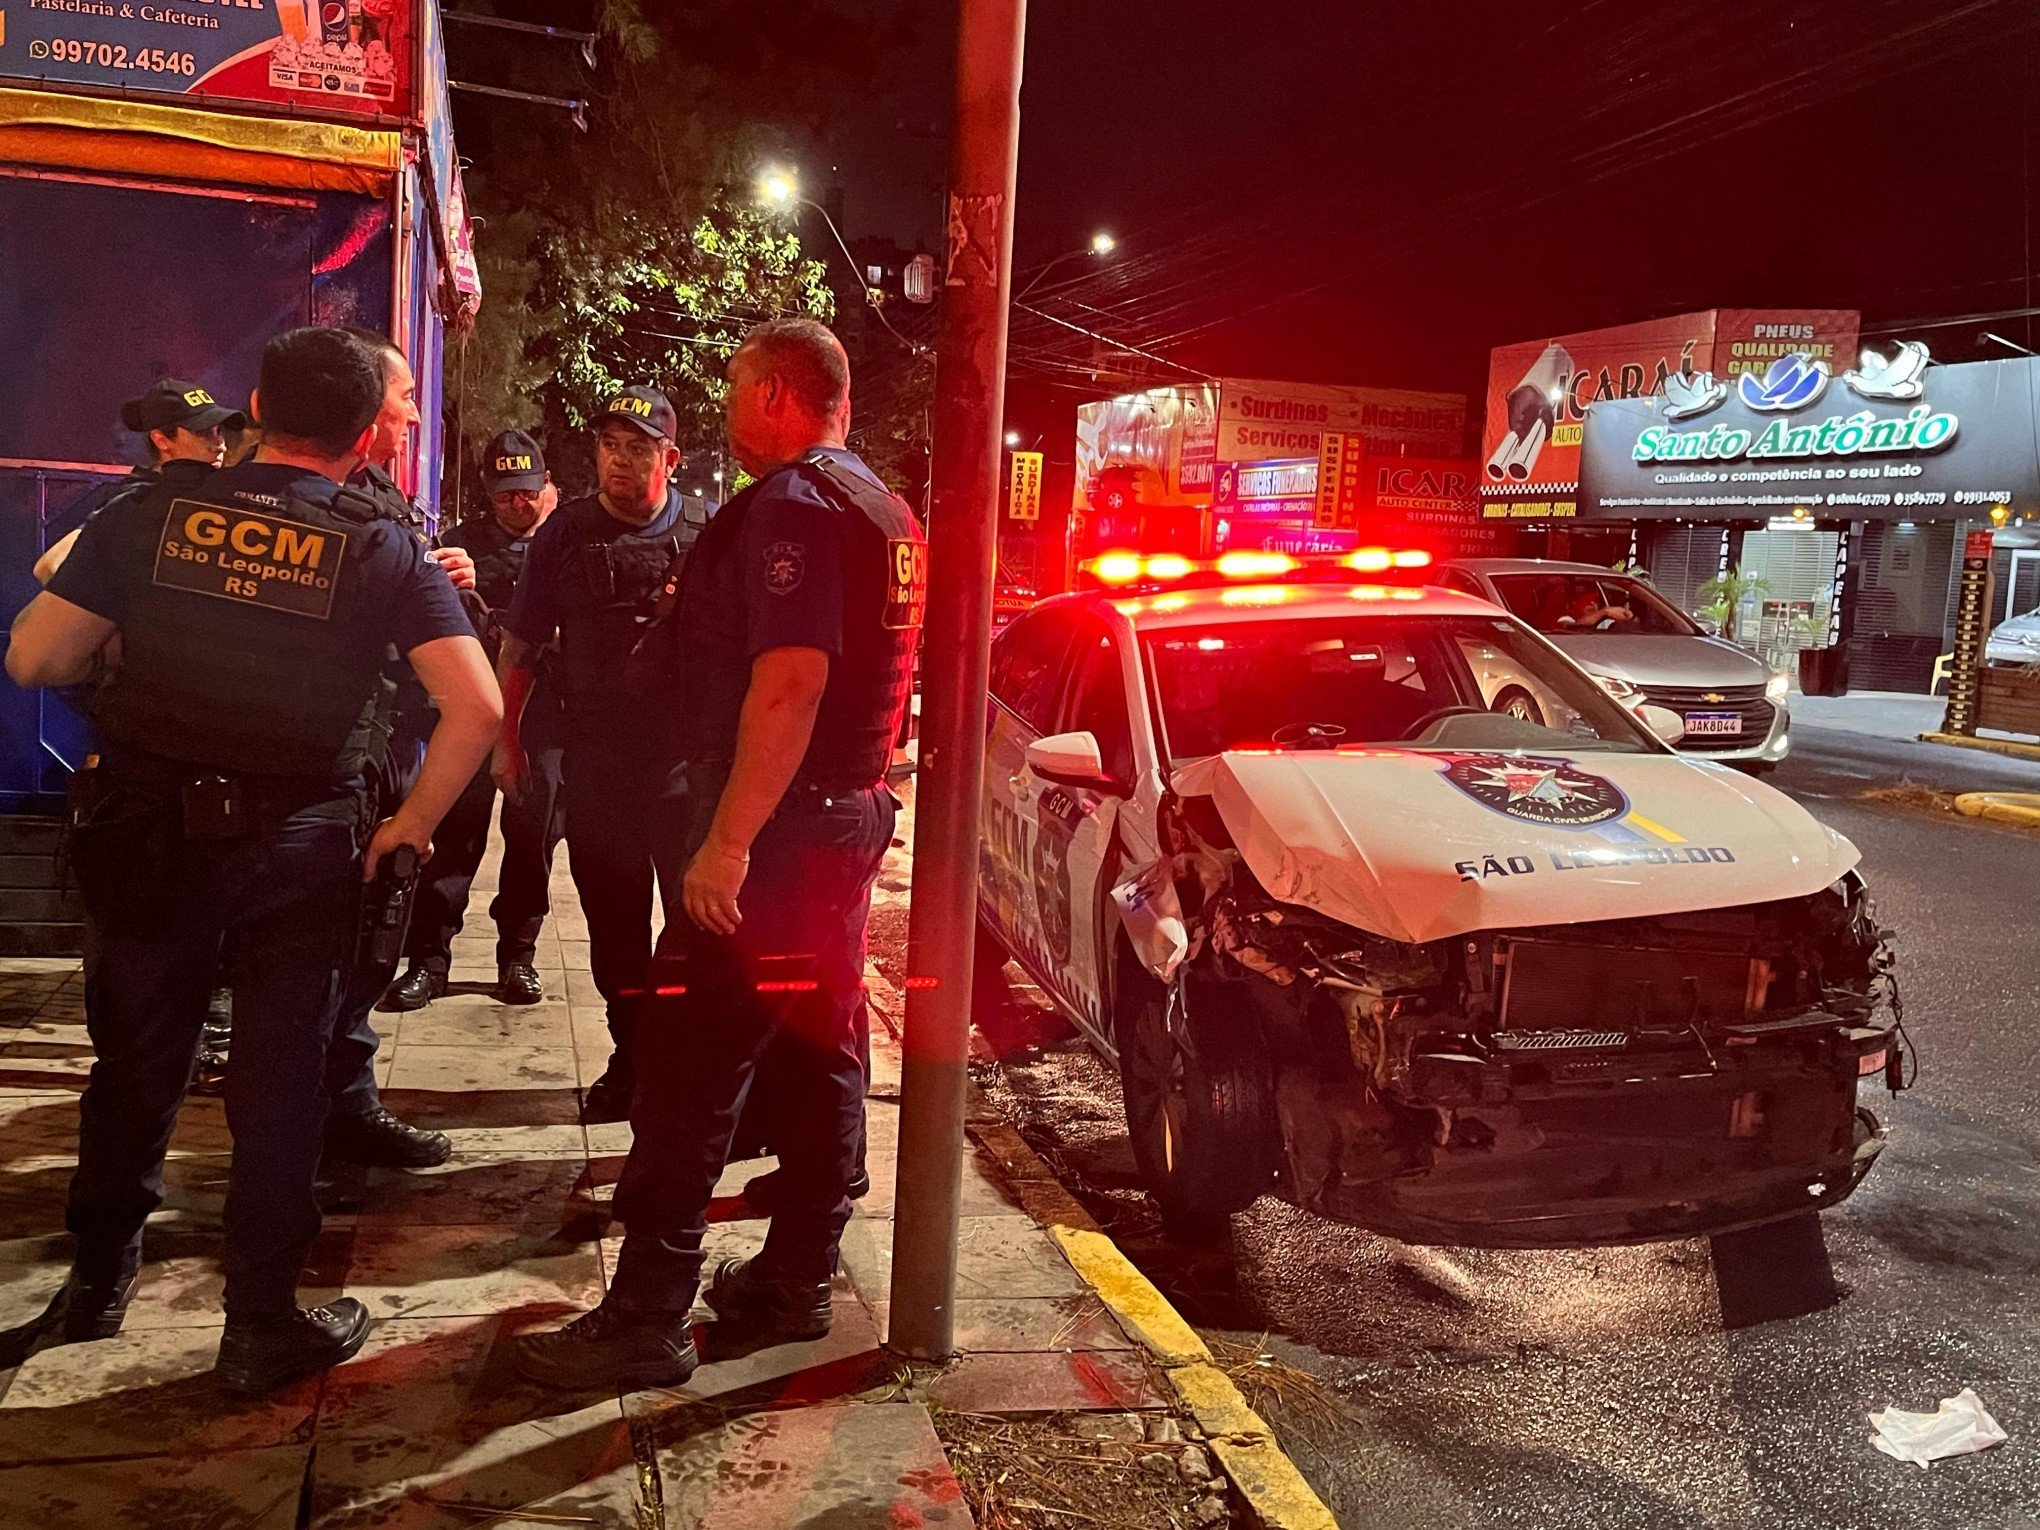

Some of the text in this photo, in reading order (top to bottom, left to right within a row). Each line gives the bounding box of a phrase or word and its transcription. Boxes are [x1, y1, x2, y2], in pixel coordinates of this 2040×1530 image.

[30, 0, 220, 29] Pastelaria & Cafeteria
[51, 38, 196, 76] 99702.4546
[310, 60, 357, 73] ACEITAMOS
[277, 72, 294, 81] VISA
[1754, 324, 1815, 339] PNEUS
[1731, 342, 1834, 358] QUALIDADE
[608, 397, 652, 418] GCM
[1240, 395, 1329, 423] Surdinas
[1237, 427, 1320, 451] Serviços
[1555, 427, 1582, 443] AUTO
[1632, 404, 1959, 462] Santo Antônio
[496, 455, 532, 471] GCM
[1654, 463, 1923, 485] Qualidade e competência ao seu lado
[1380, 498, 1455, 510] AUTO CENTER
[1406, 512, 1476, 525] SURDINAS
[184, 511, 325, 569] GCM
[163, 540, 329, 590] São Leopoldo
[224, 576, 258, 598] RS
[890, 586, 909, 604] São
[1828, 530, 1849, 647] CAPELAS
[909, 606, 921, 624] RS
[1689, 720, 1737, 732] JAK8D44
[1050, 793, 1073, 819] GCM
[1506, 806, 1552, 824] GUARDA
[1553, 816, 1579, 825] CIVIL
[1454, 853, 1536, 883] SÃO
